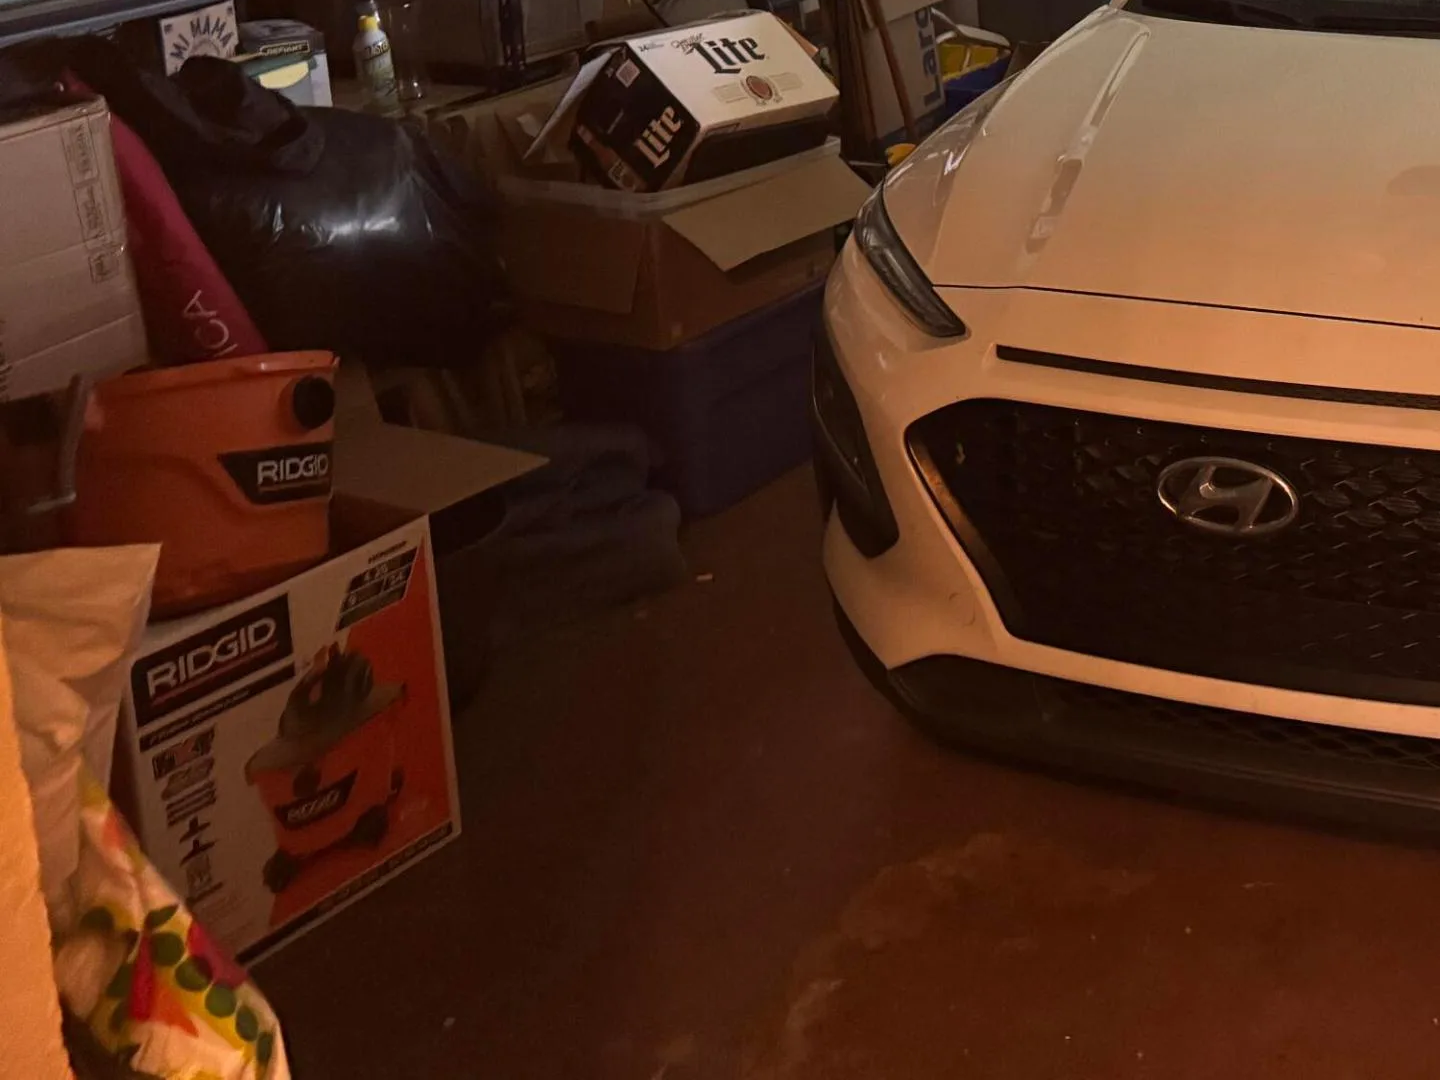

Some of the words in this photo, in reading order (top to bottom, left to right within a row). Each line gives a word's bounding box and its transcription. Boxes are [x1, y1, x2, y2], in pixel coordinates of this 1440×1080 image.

[190, 15, 234, 48] MAMA
[686, 36, 765, 74] Lite
[634, 106, 683, 169] Lite
[257, 454, 329, 485] RIDGID
[146, 617, 276, 700] RIDGID
